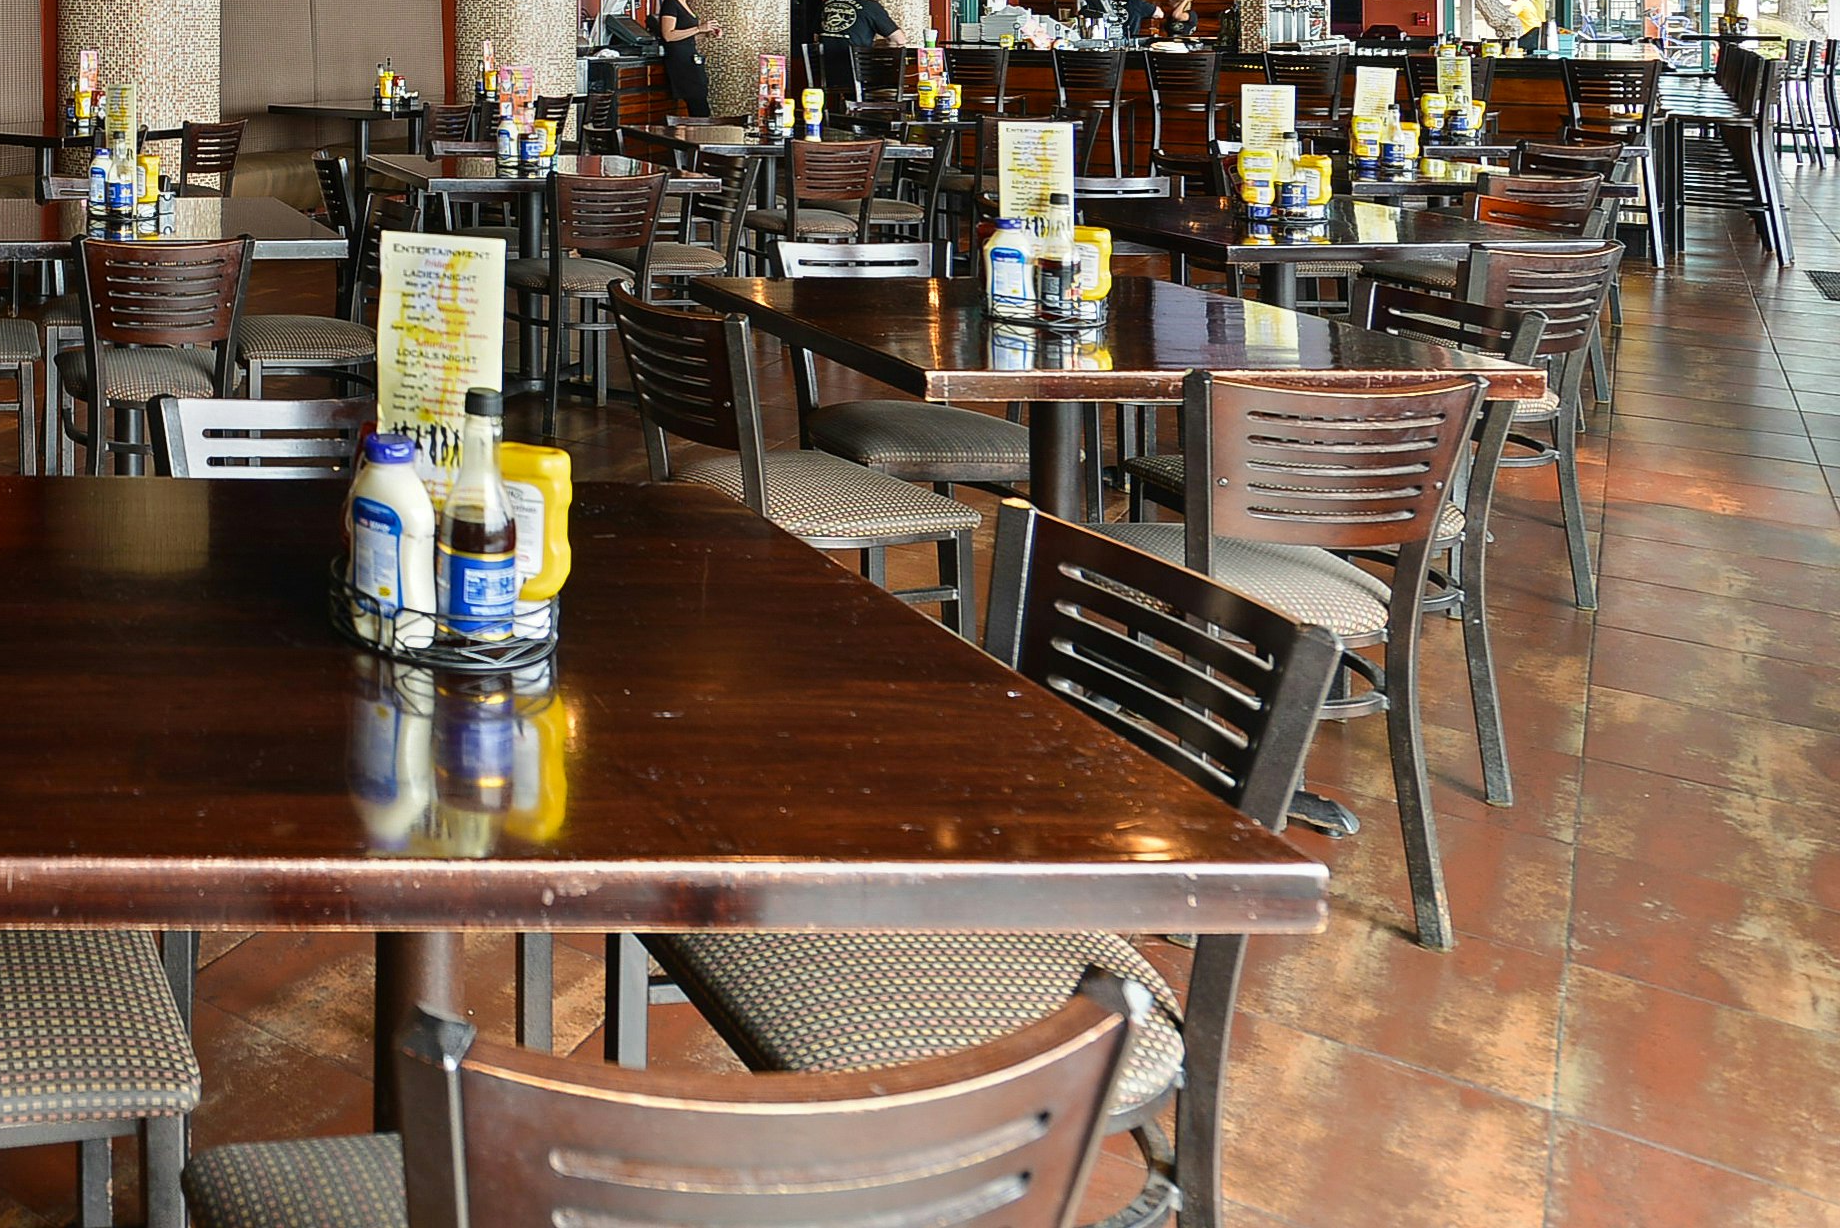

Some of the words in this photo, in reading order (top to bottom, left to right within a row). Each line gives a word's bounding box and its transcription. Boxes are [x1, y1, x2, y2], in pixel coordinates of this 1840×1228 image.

[393, 243, 490, 260] ENTERTAINMENT
[403, 269, 440, 279] LADIES
[442, 272, 477, 283] NIGHT
[397, 348, 439, 359] LOCALS
[442, 354, 477, 364] NIGHT
